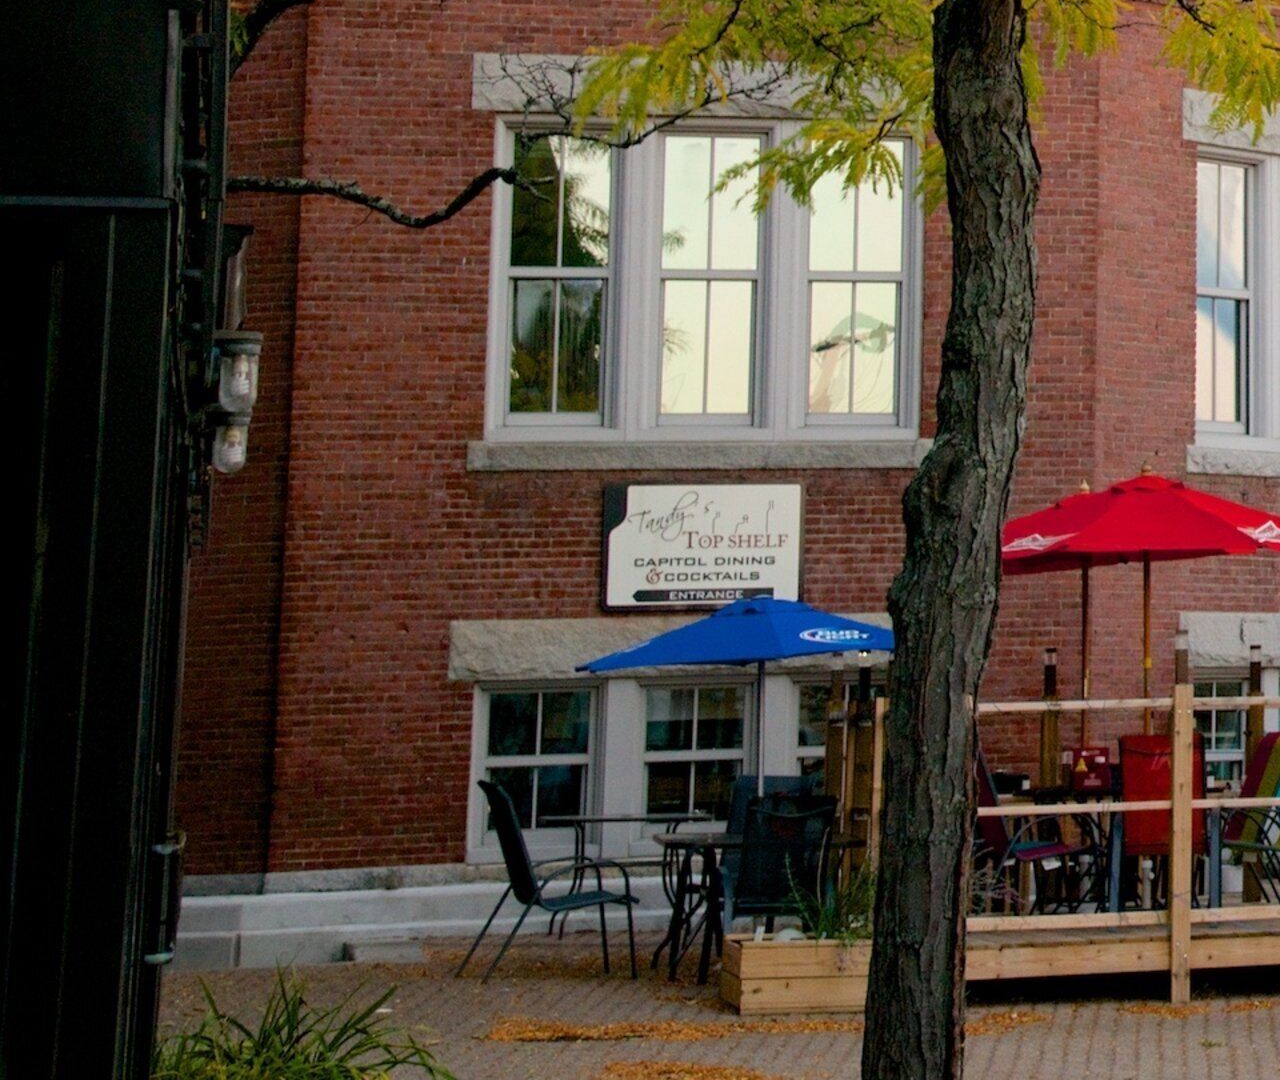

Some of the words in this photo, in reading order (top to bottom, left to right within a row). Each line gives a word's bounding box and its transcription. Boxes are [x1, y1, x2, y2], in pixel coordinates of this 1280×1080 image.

[728, 533, 789, 549] SHELF
[634, 557, 707, 568] CAPITOL
[714, 555, 776, 566] DINING
[664, 571, 760, 582] COCKTAILS
[668, 589, 743, 601] ENTRANCE
